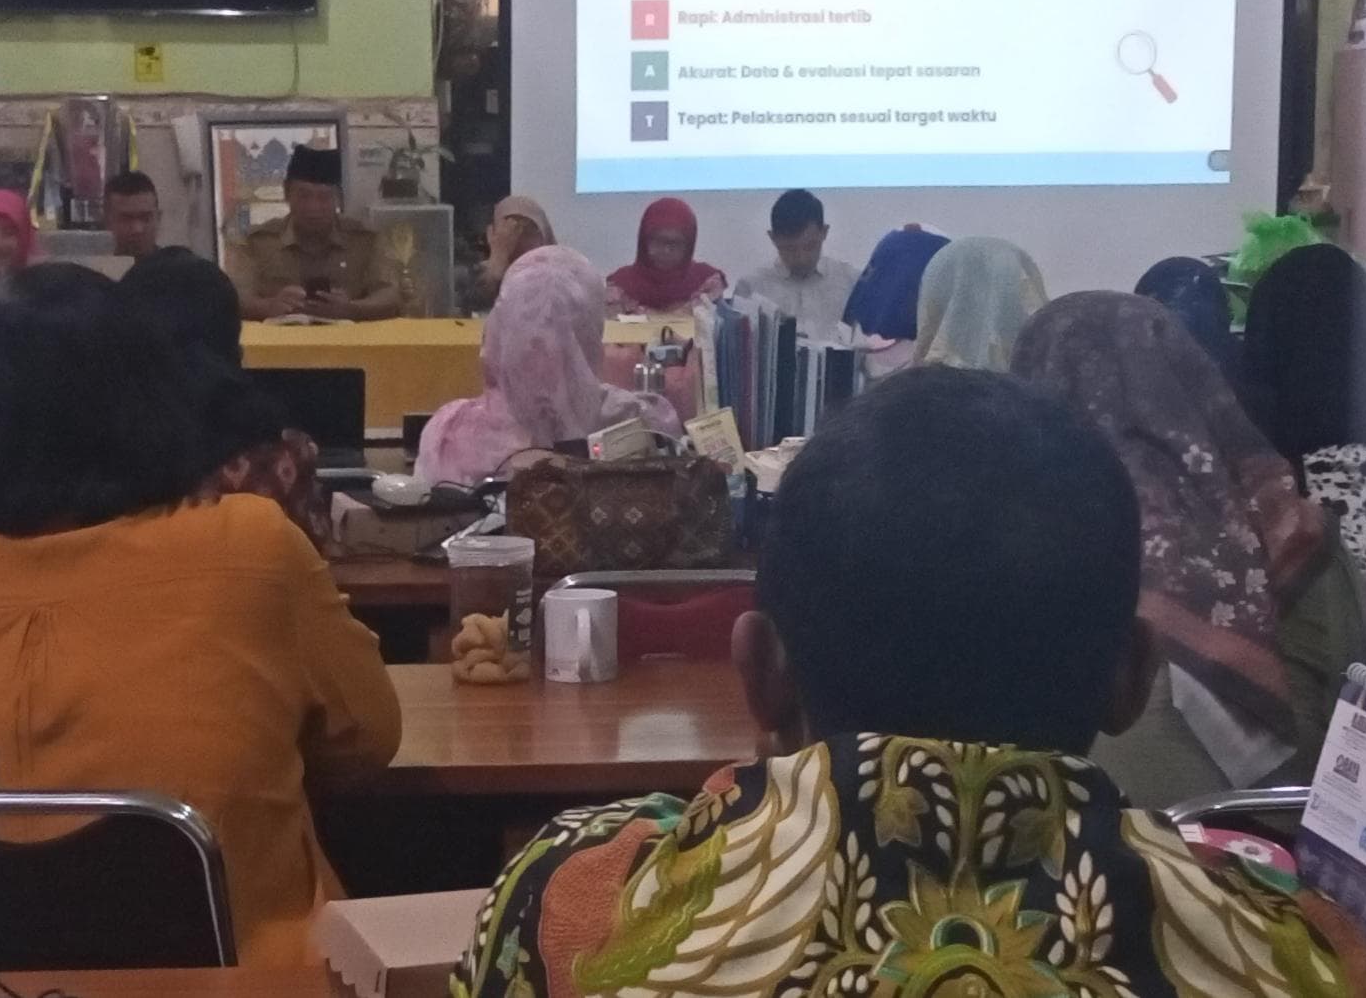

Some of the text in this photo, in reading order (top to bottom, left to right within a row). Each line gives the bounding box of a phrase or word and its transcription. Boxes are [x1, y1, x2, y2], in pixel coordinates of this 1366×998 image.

[677, 8, 873, 28] Rapi: Administrasi tertib
[644, 64, 656, 78] A
[677, 64, 982, 81] Akurat: Data & evaluasi tepat sasaran
[644, 114, 655, 128] T
[677, 108, 997, 129] Tepat: Pelaksanaan sesuai target waktu
